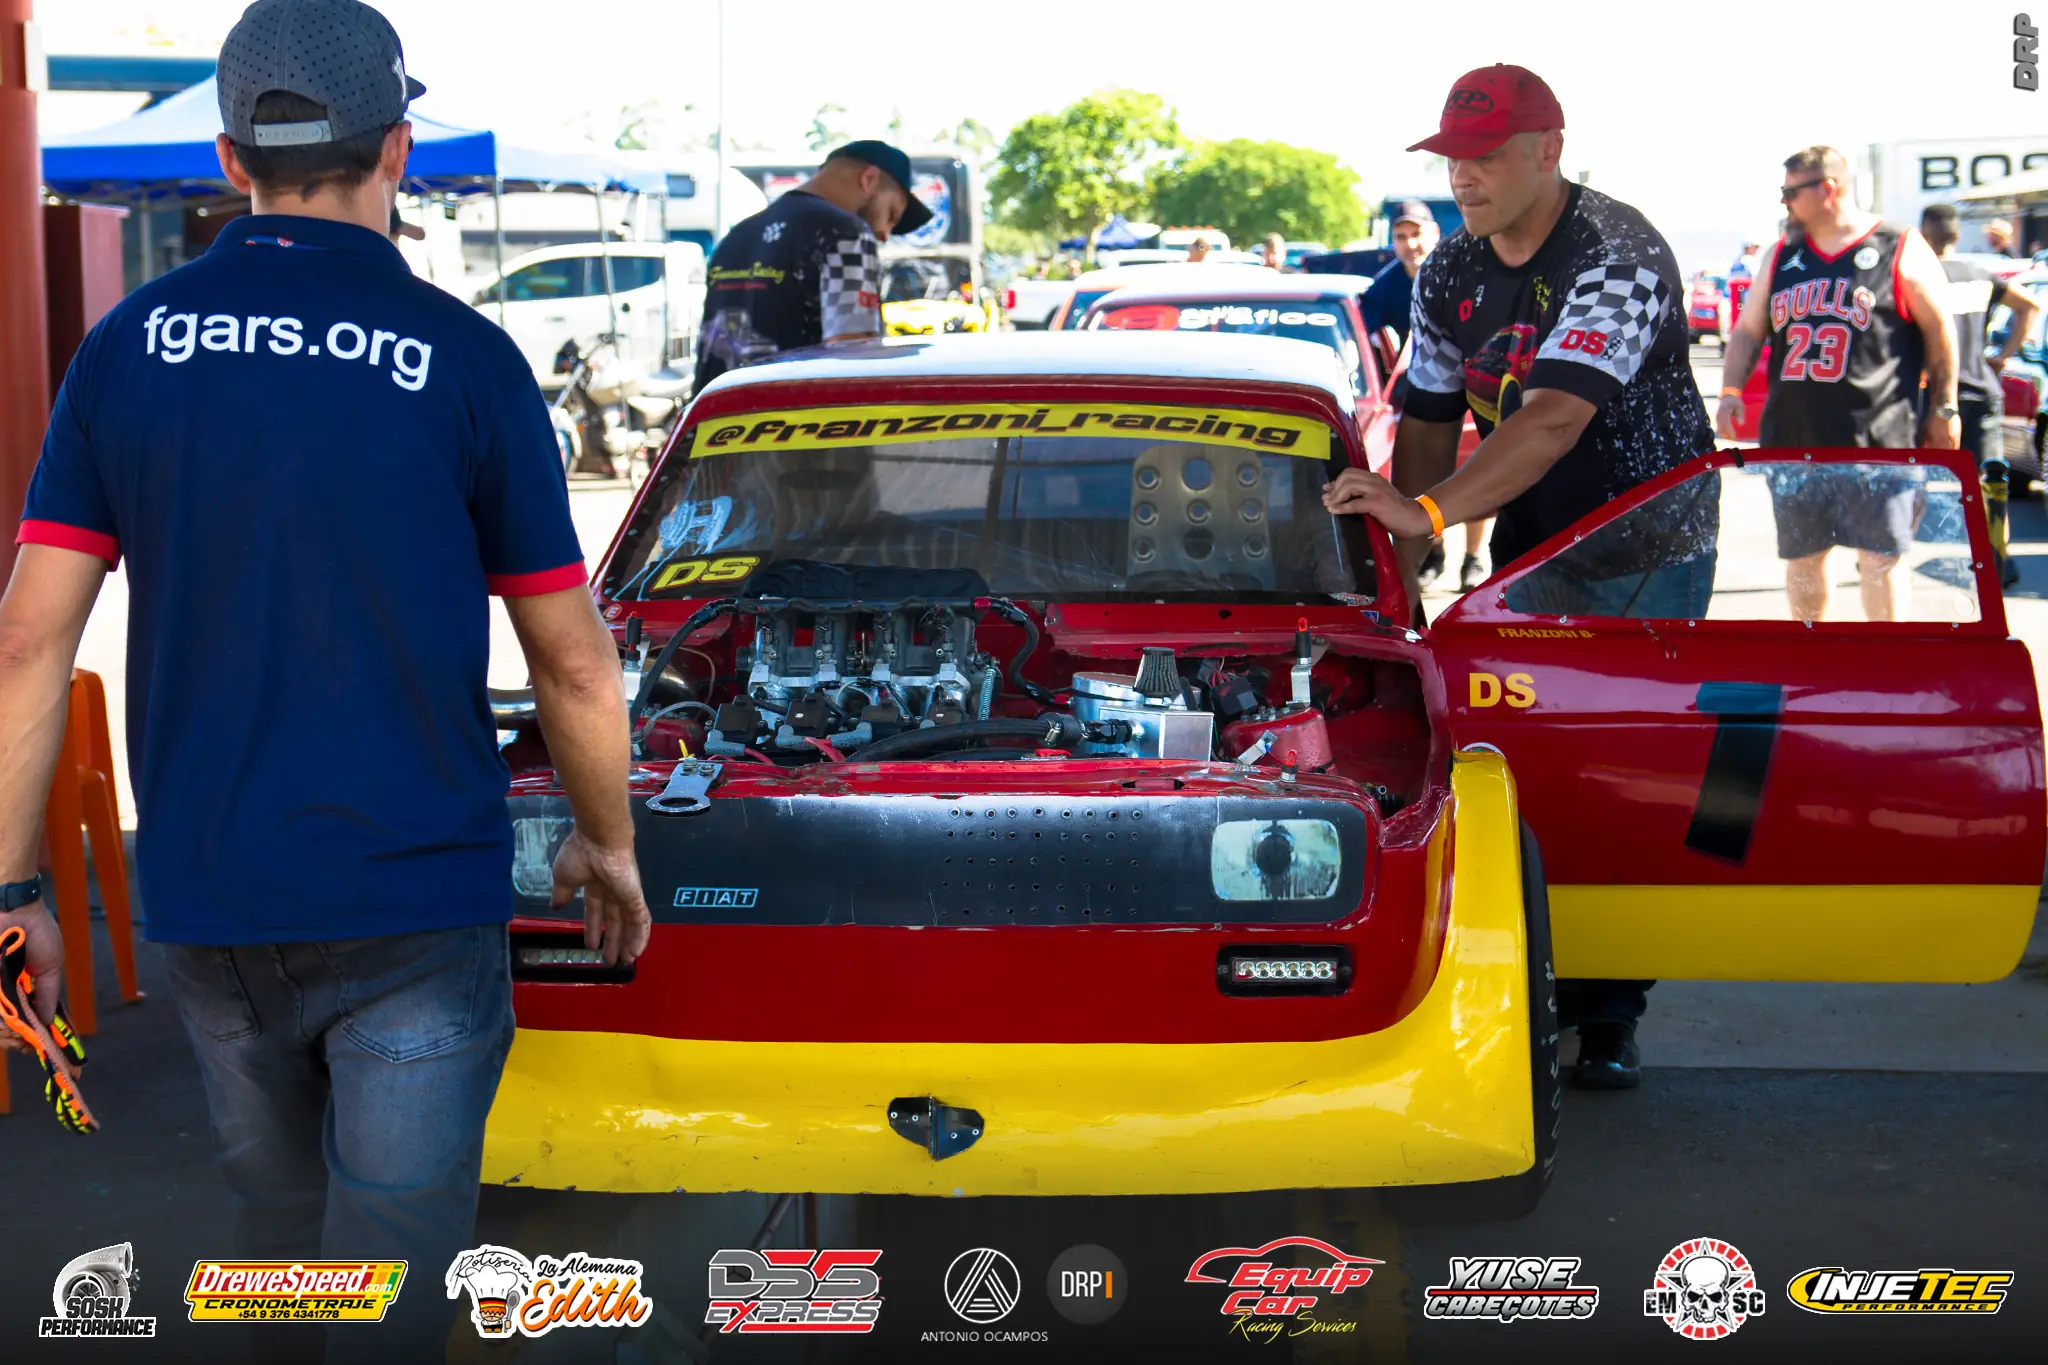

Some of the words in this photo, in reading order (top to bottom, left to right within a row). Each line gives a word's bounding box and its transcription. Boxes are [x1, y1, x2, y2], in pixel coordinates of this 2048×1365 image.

[1771, 276, 1876, 333] BULLS
[144, 305, 432, 391] fgars.org
[1559, 329, 1608, 355] DS
[1781, 322, 1852, 382] 23
[705, 408, 1302, 448] @franzoni_racing
[650, 555, 760, 592] DS
[1497, 628, 1577, 639] FRANZONI
[1469, 673, 1537, 708] DS
[677, 889, 755, 905] FIAT
